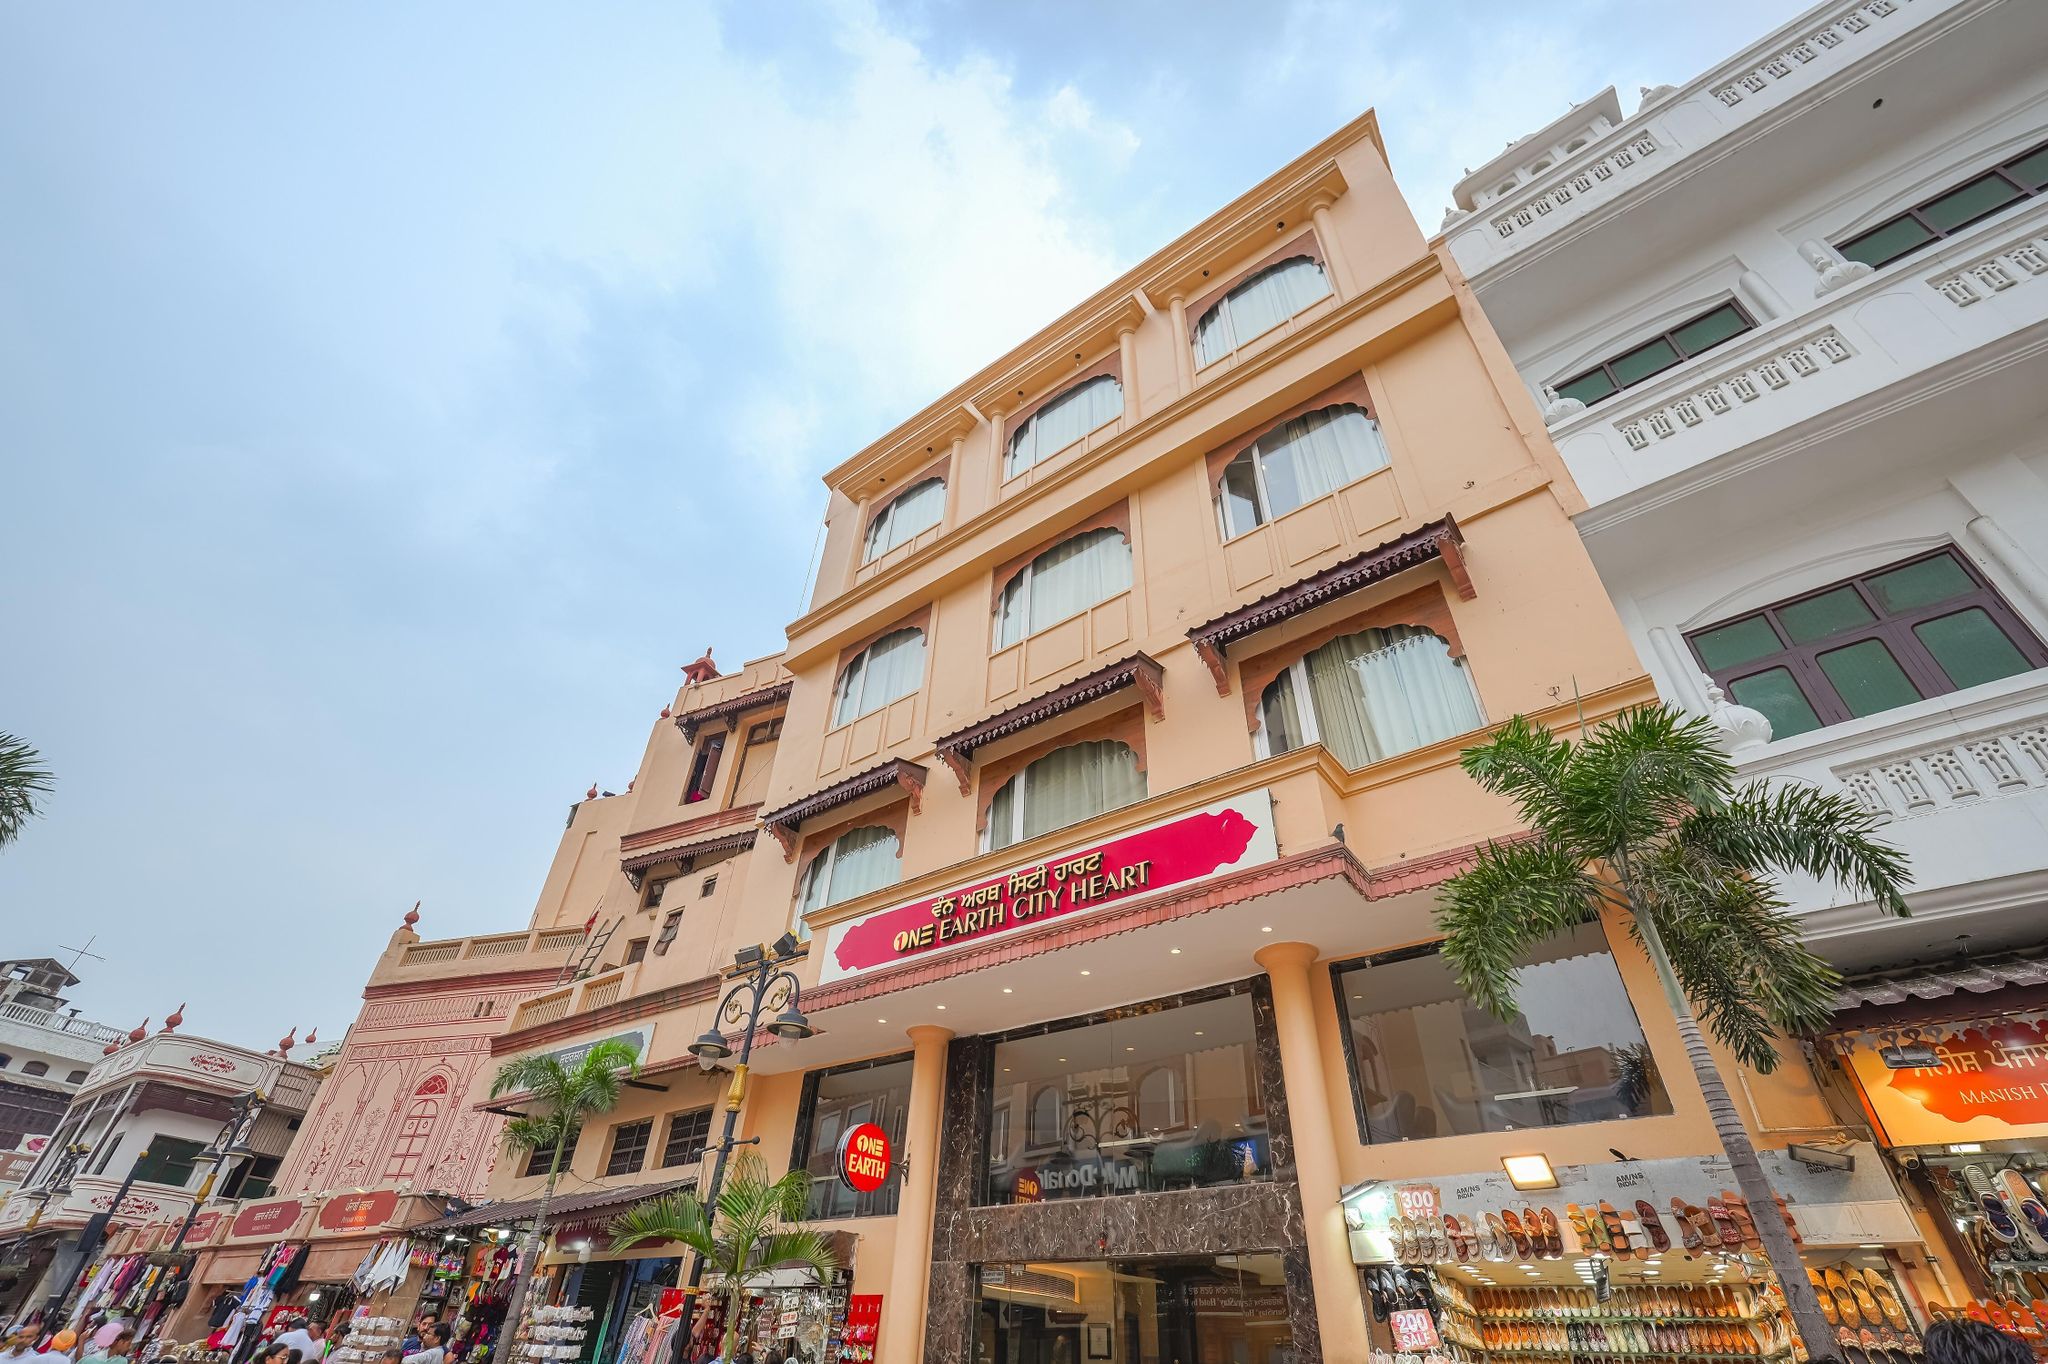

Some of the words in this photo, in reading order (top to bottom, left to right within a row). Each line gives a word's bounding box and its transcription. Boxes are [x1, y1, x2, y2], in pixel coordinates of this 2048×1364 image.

[1008, 864, 1049, 896] ਸਿਟੀ
[1054, 851, 1102, 881] ਹਾਰਟ
[893, 923, 934, 952] ONE
[940, 903, 1004, 940] EARTH
[1013, 886, 1063, 919] CITY
[1071, 860, 1150, 903] HEART
[1960, 1086, 2038, 1104] MANISH
[857, 1134, 884, 1157] ONE
[848, 1153, 886, 1179] EARTH
[1808, 1165, 1832, 1174] INDIA
[1616, 1172, 1644, 1183] AM/NS
[1617, 1180, 1638, 1188] INDIA
[1456, 1185, 1481, 1195] AM/NS
[1457, 1192, 1475, 1200] INDIA
[1401, 1191, 1434, 1209] 300
[1396, 1313, 1429, 1334] 200
[1402, 1332, 1431, 1347] SALE
